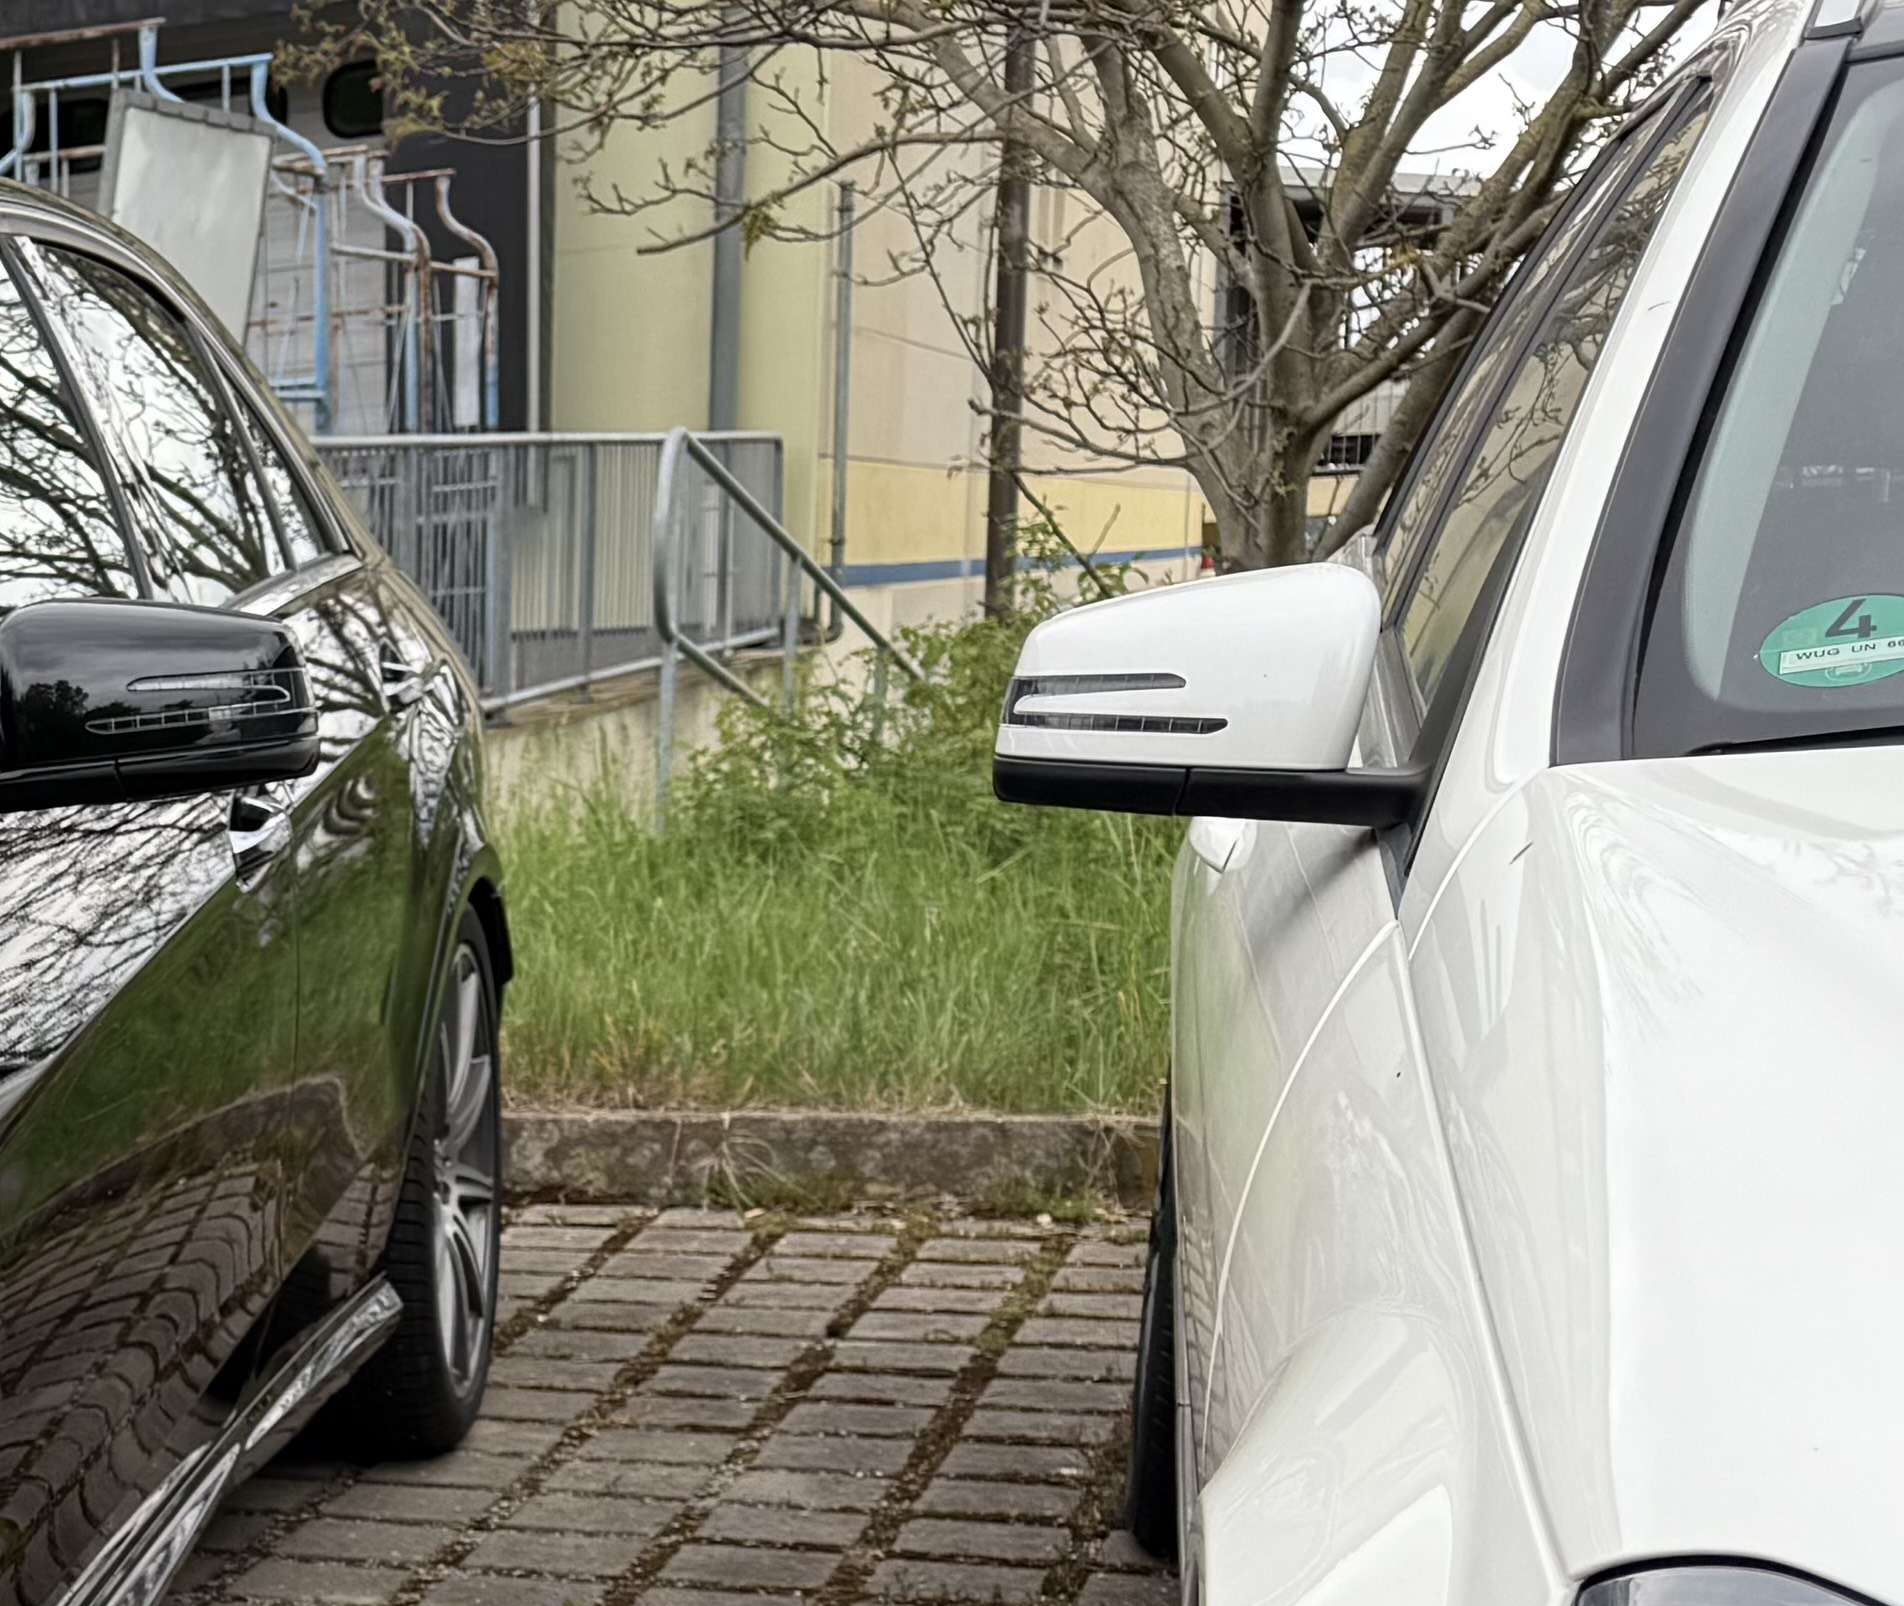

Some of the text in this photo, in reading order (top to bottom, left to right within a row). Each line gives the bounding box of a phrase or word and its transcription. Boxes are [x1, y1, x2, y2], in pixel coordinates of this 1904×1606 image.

[1825, 598, 1877, 639] 4
[1796, 648, 1841, 660] WUG
[1851, 642, 1877, 653] UN
